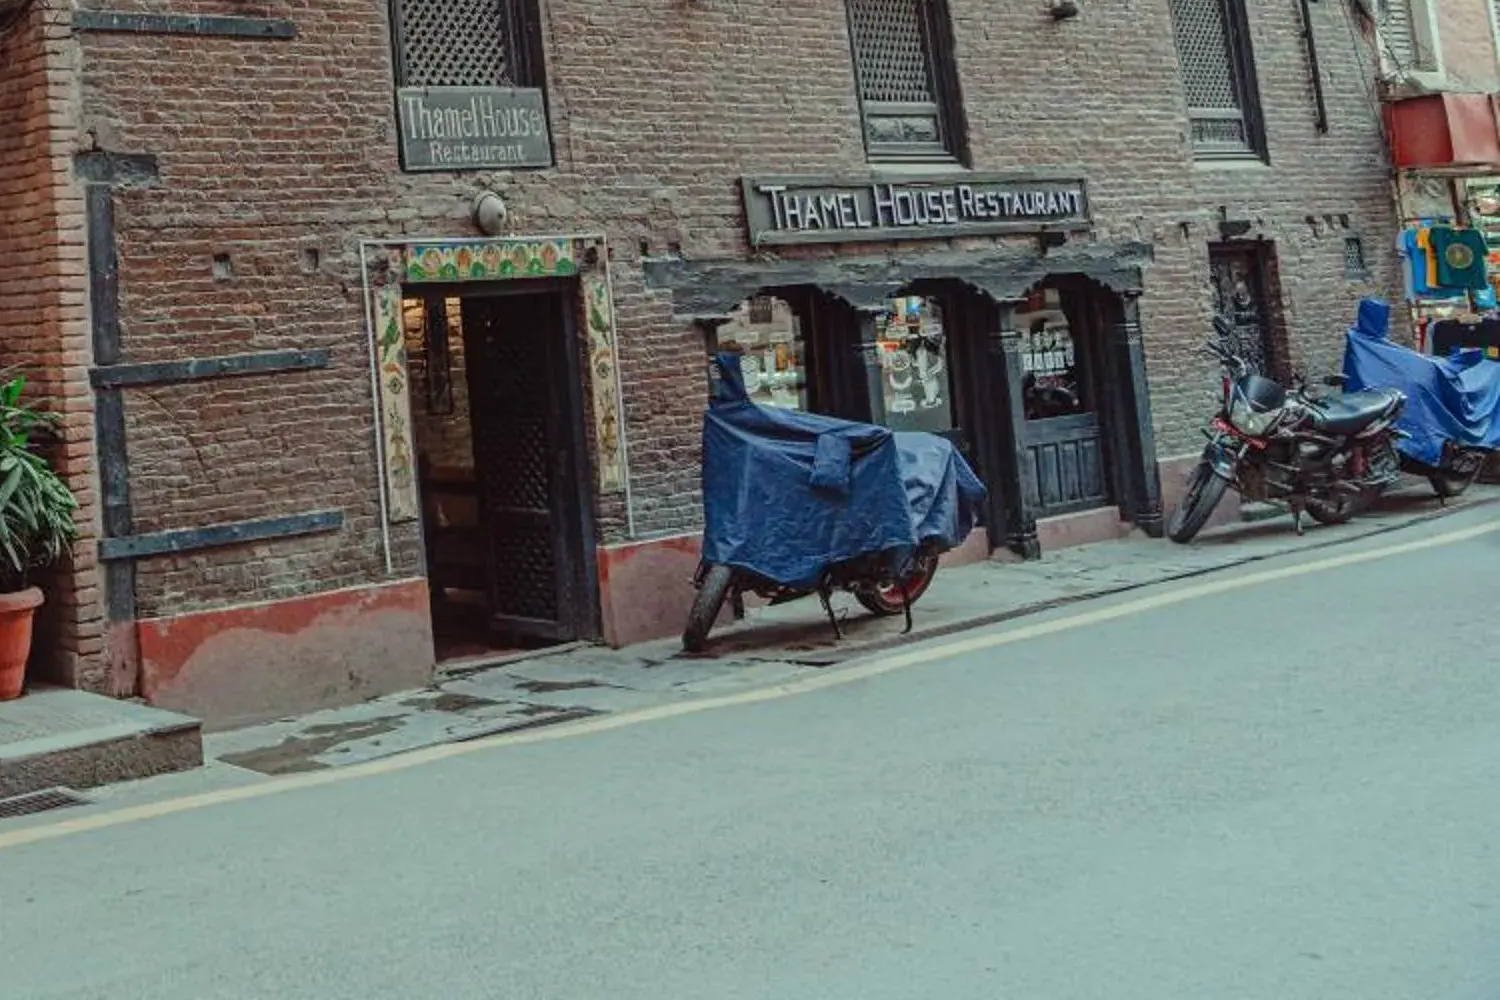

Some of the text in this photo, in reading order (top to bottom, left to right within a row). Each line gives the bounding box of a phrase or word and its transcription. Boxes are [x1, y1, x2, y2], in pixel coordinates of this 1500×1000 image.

[403, 96, 542, 139] Thamel House
[429, 141, 525, 163] Restaurant
[759, 184, 1082, 230] THAMEL HOUSE RESTAURANT
